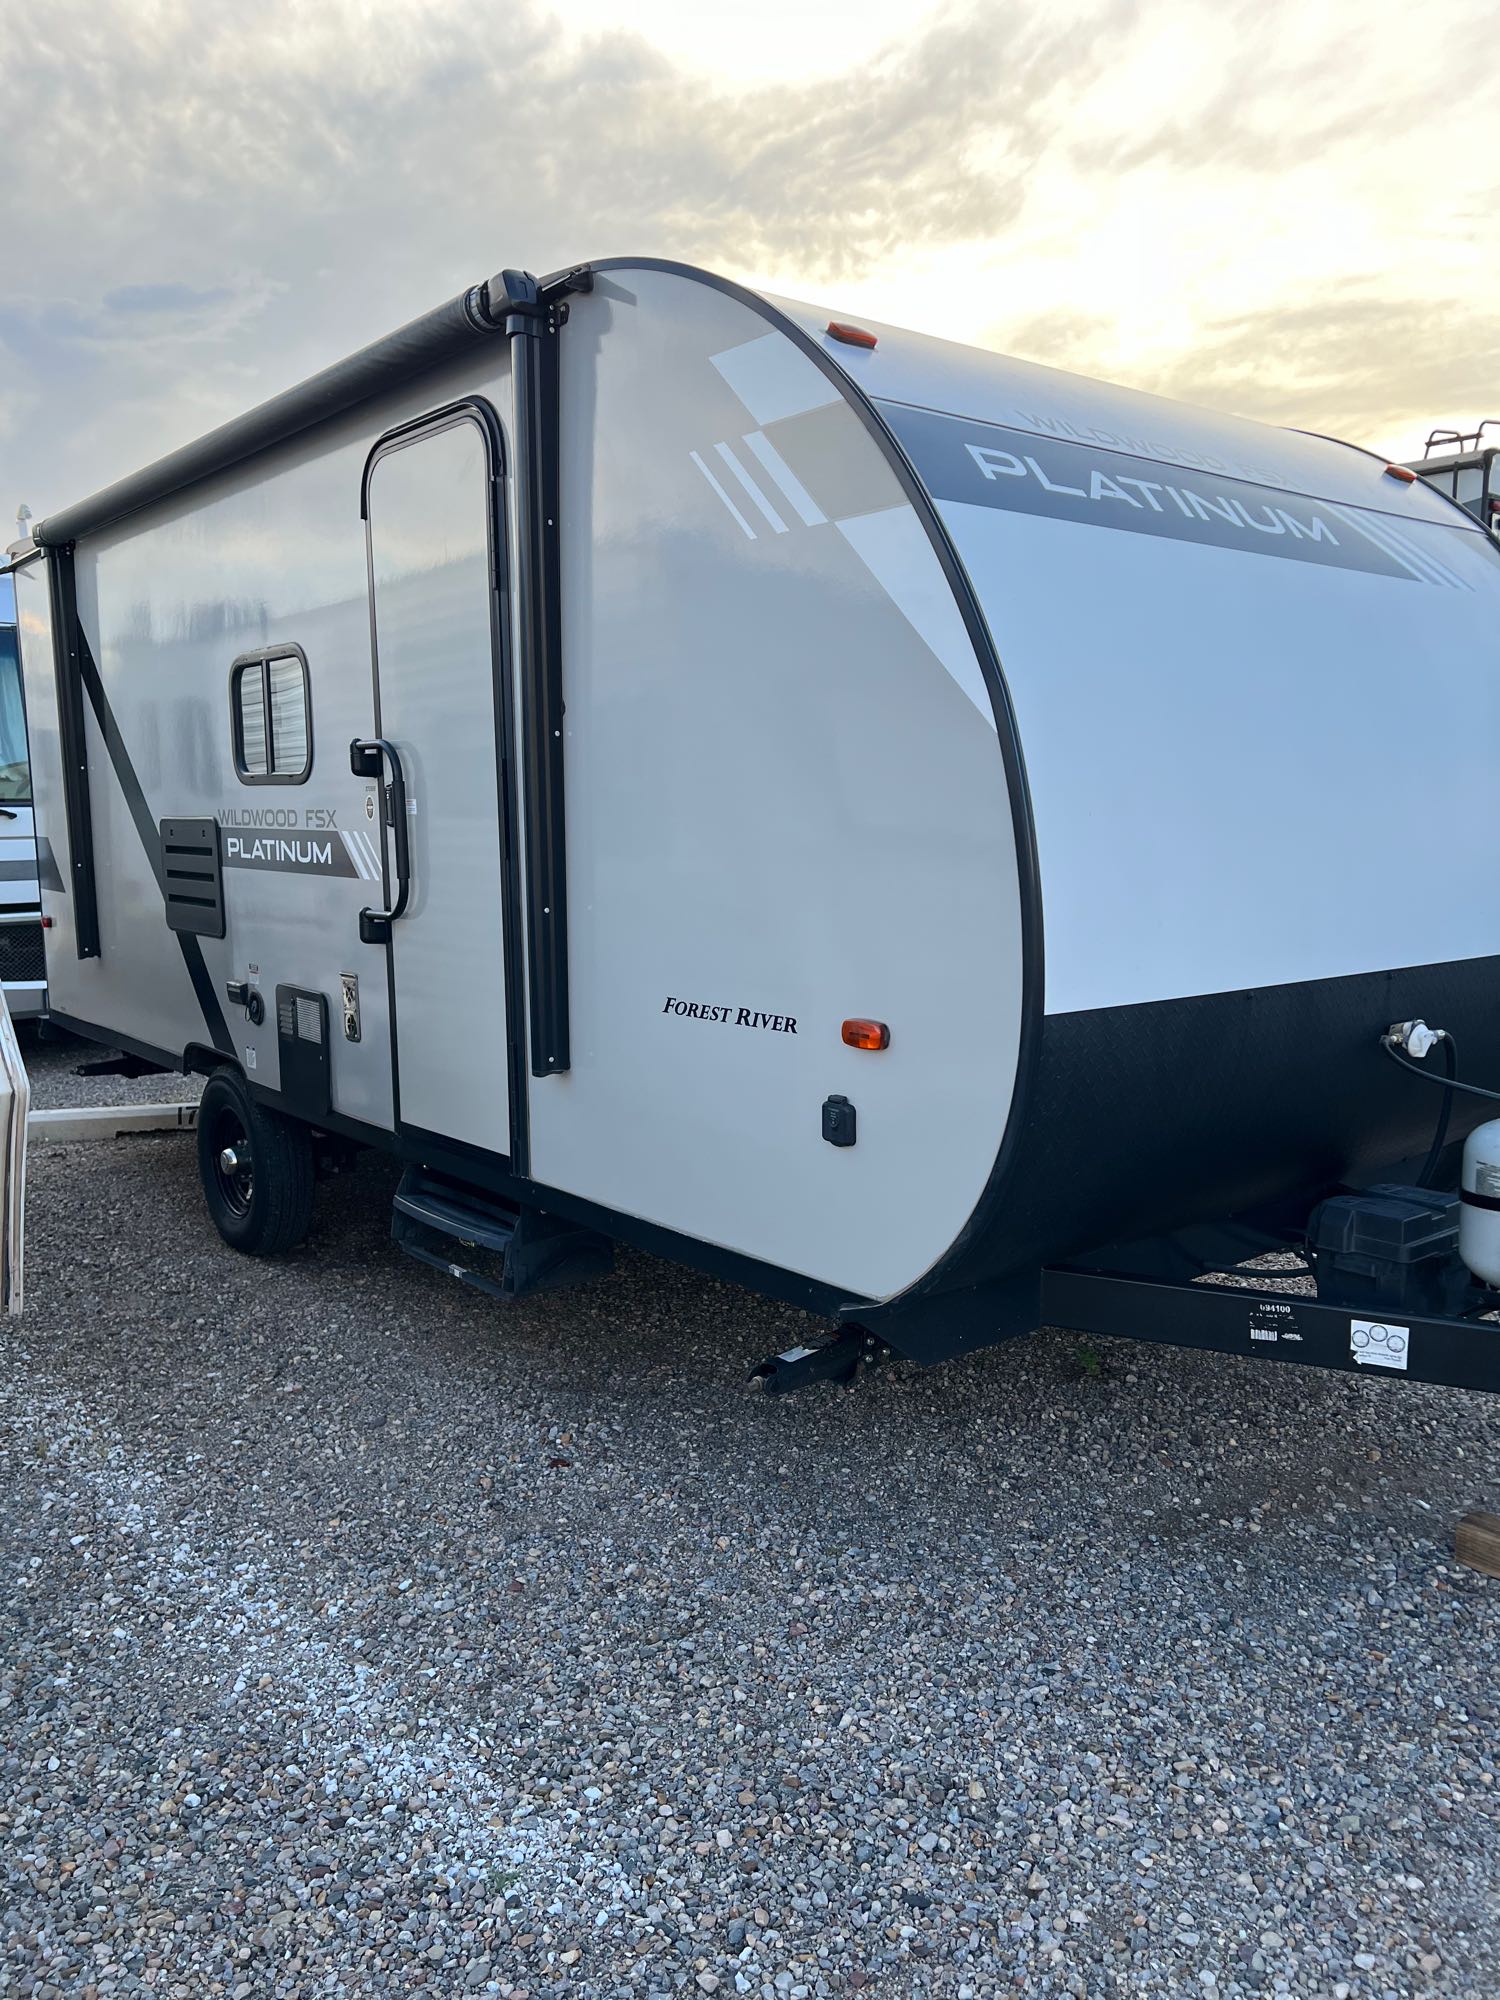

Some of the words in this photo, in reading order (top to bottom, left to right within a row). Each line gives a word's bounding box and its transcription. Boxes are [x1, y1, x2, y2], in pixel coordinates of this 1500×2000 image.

[1015, 408, 1227, 471] WILDWOOD
[964, 443, 1340, 545] PLATINUM
[217, 808, 298, 828] WILDWOOD
[305, 809, 338, 829] FSX
[227, 837, 332, 865] PLATINUM
[662, 996, 732, 1023] FOREST
[734, 1007, 798, 1034] RIVER
